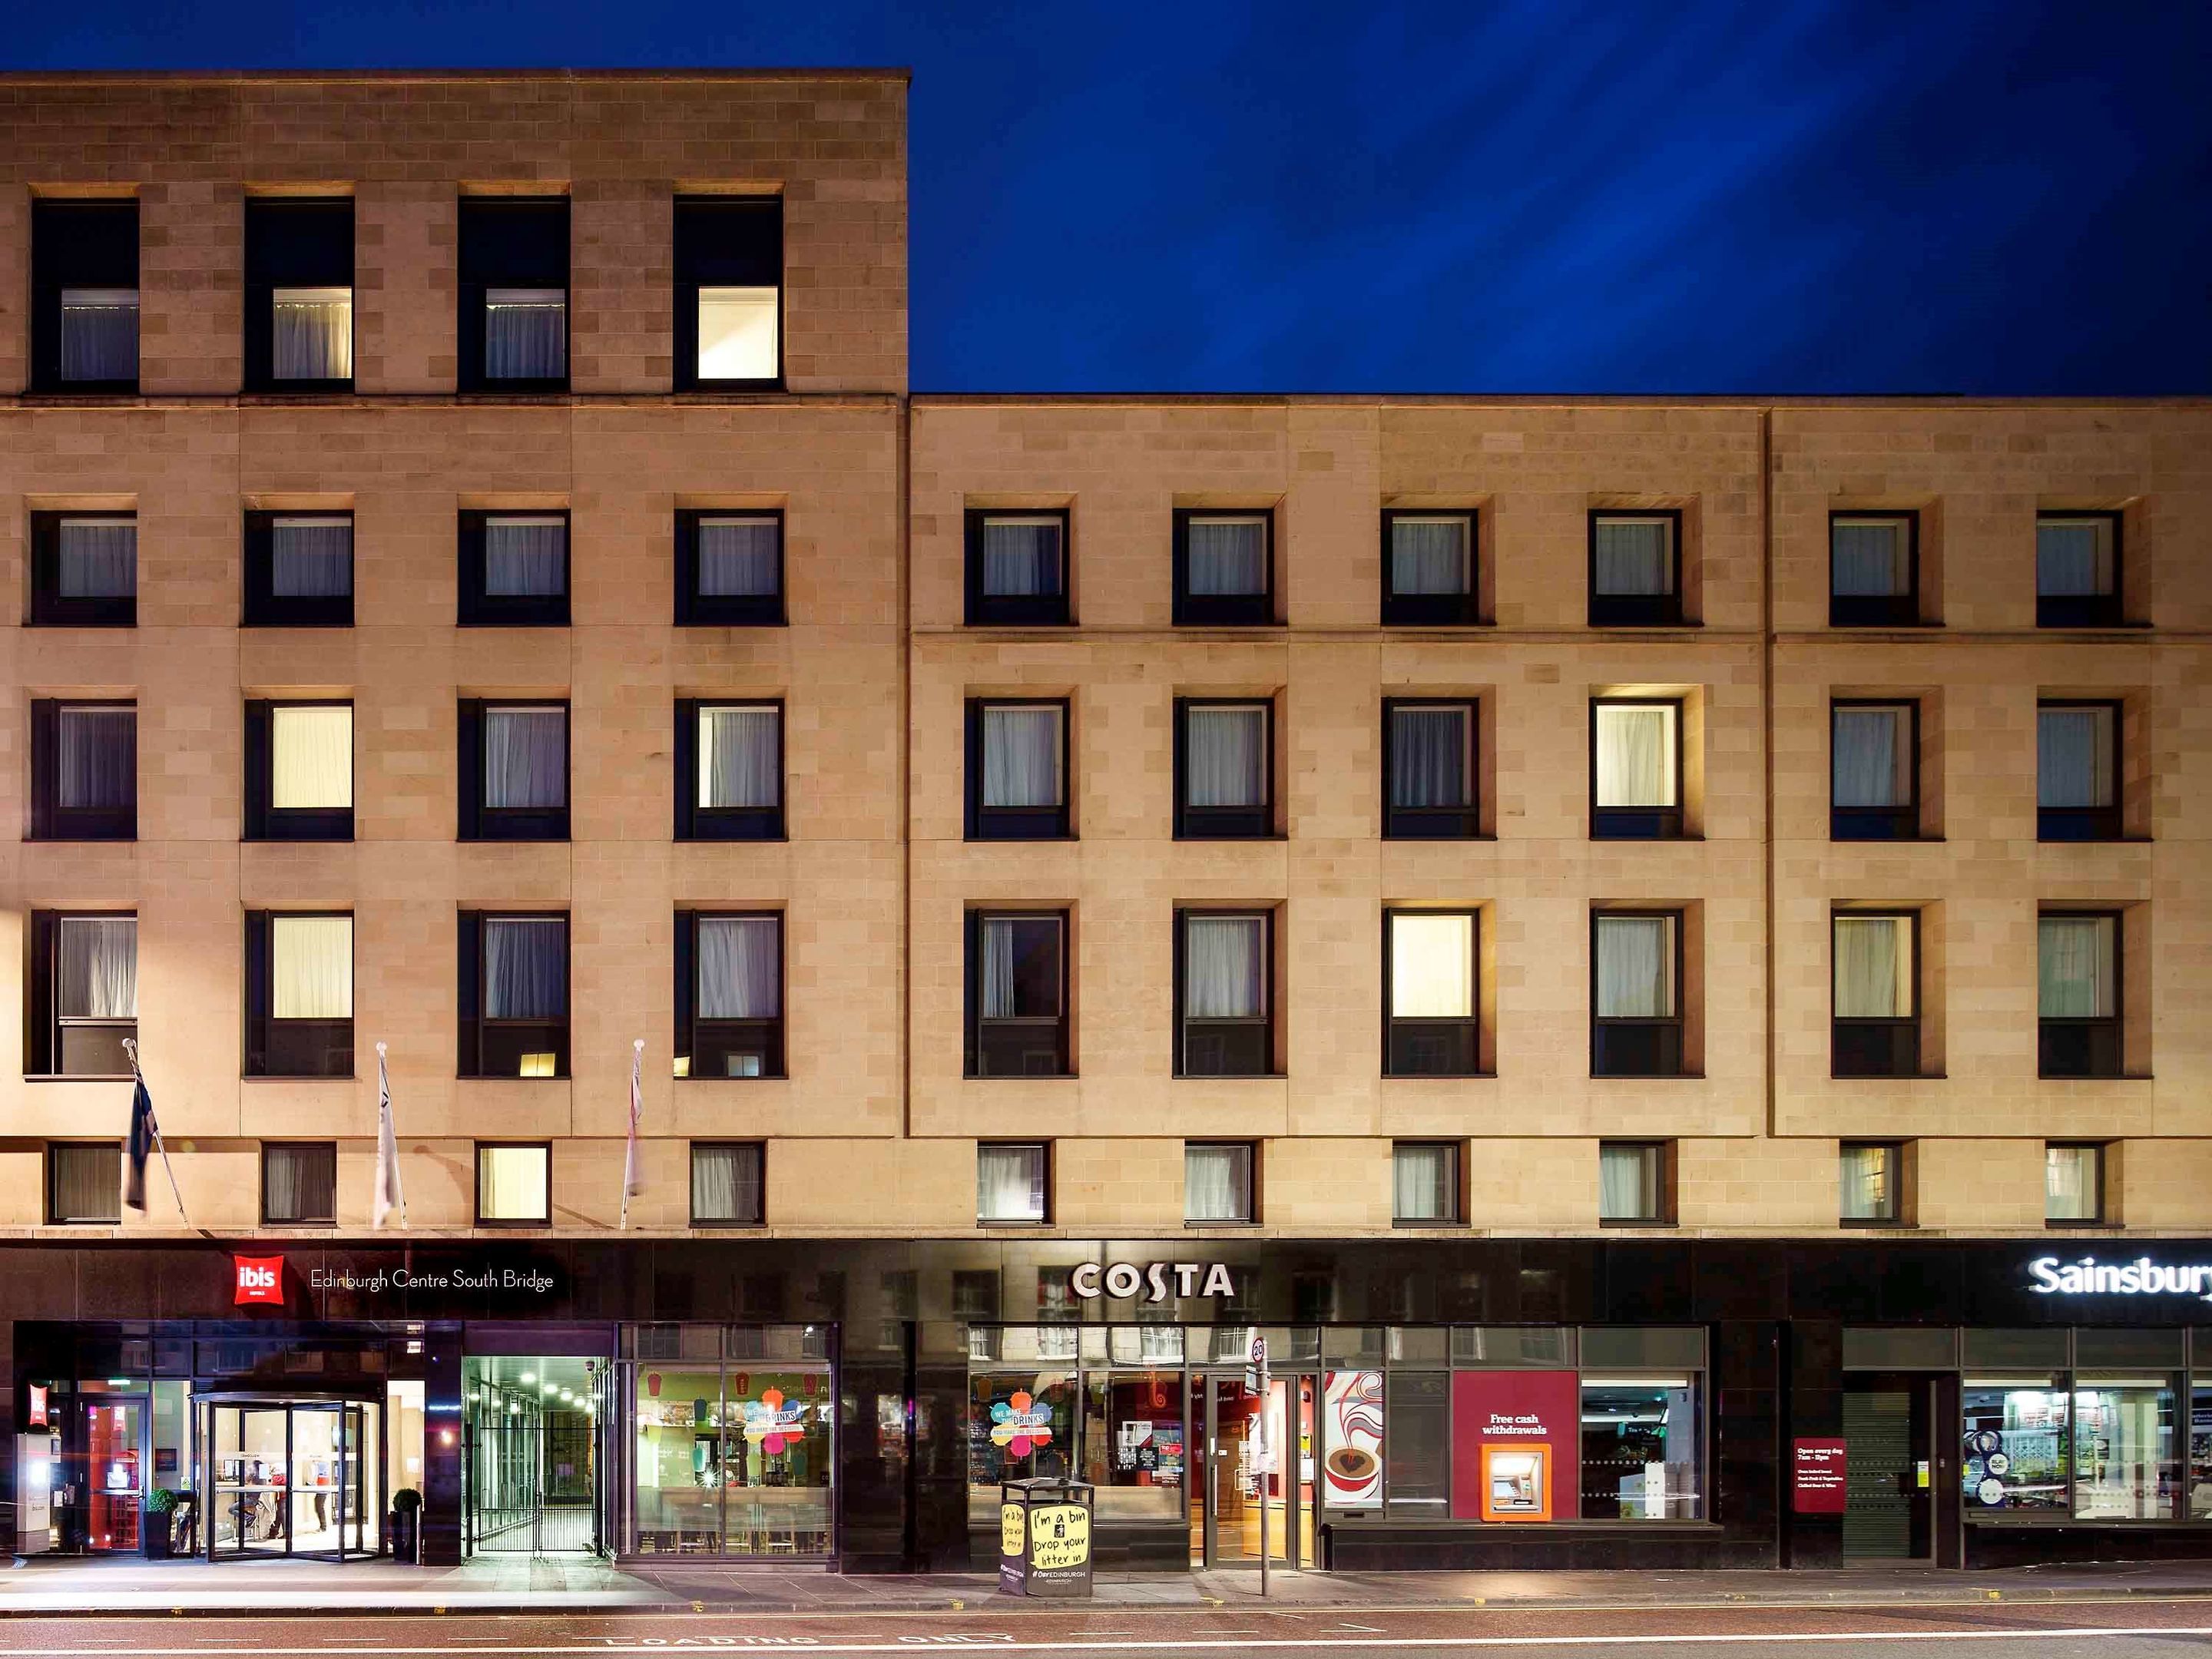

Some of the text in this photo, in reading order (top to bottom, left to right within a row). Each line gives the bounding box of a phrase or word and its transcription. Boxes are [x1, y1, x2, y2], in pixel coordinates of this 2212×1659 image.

[239, 1267, 275, 1287] ibis
[310, 1269, 554, 1293] Edinburgh Centre South Bridge
[1070, 1262, 1235, 1303] COSTA
[1254, 1344, 1263, 1356] 20
[1014, 1415, 1044, 1425] DRINKS
[1490, 1414, 1538, 1423] Free cash
[1482, 1426, 1547, 1435] withdrawals
[1034, 1511, 1085, 1528] I'm a bin
[1034, 1537, 1086, 1551] Drop your
[1041, 1555, 1068, 1566] litter
[604, 1637, 820, 1646] LOADING
